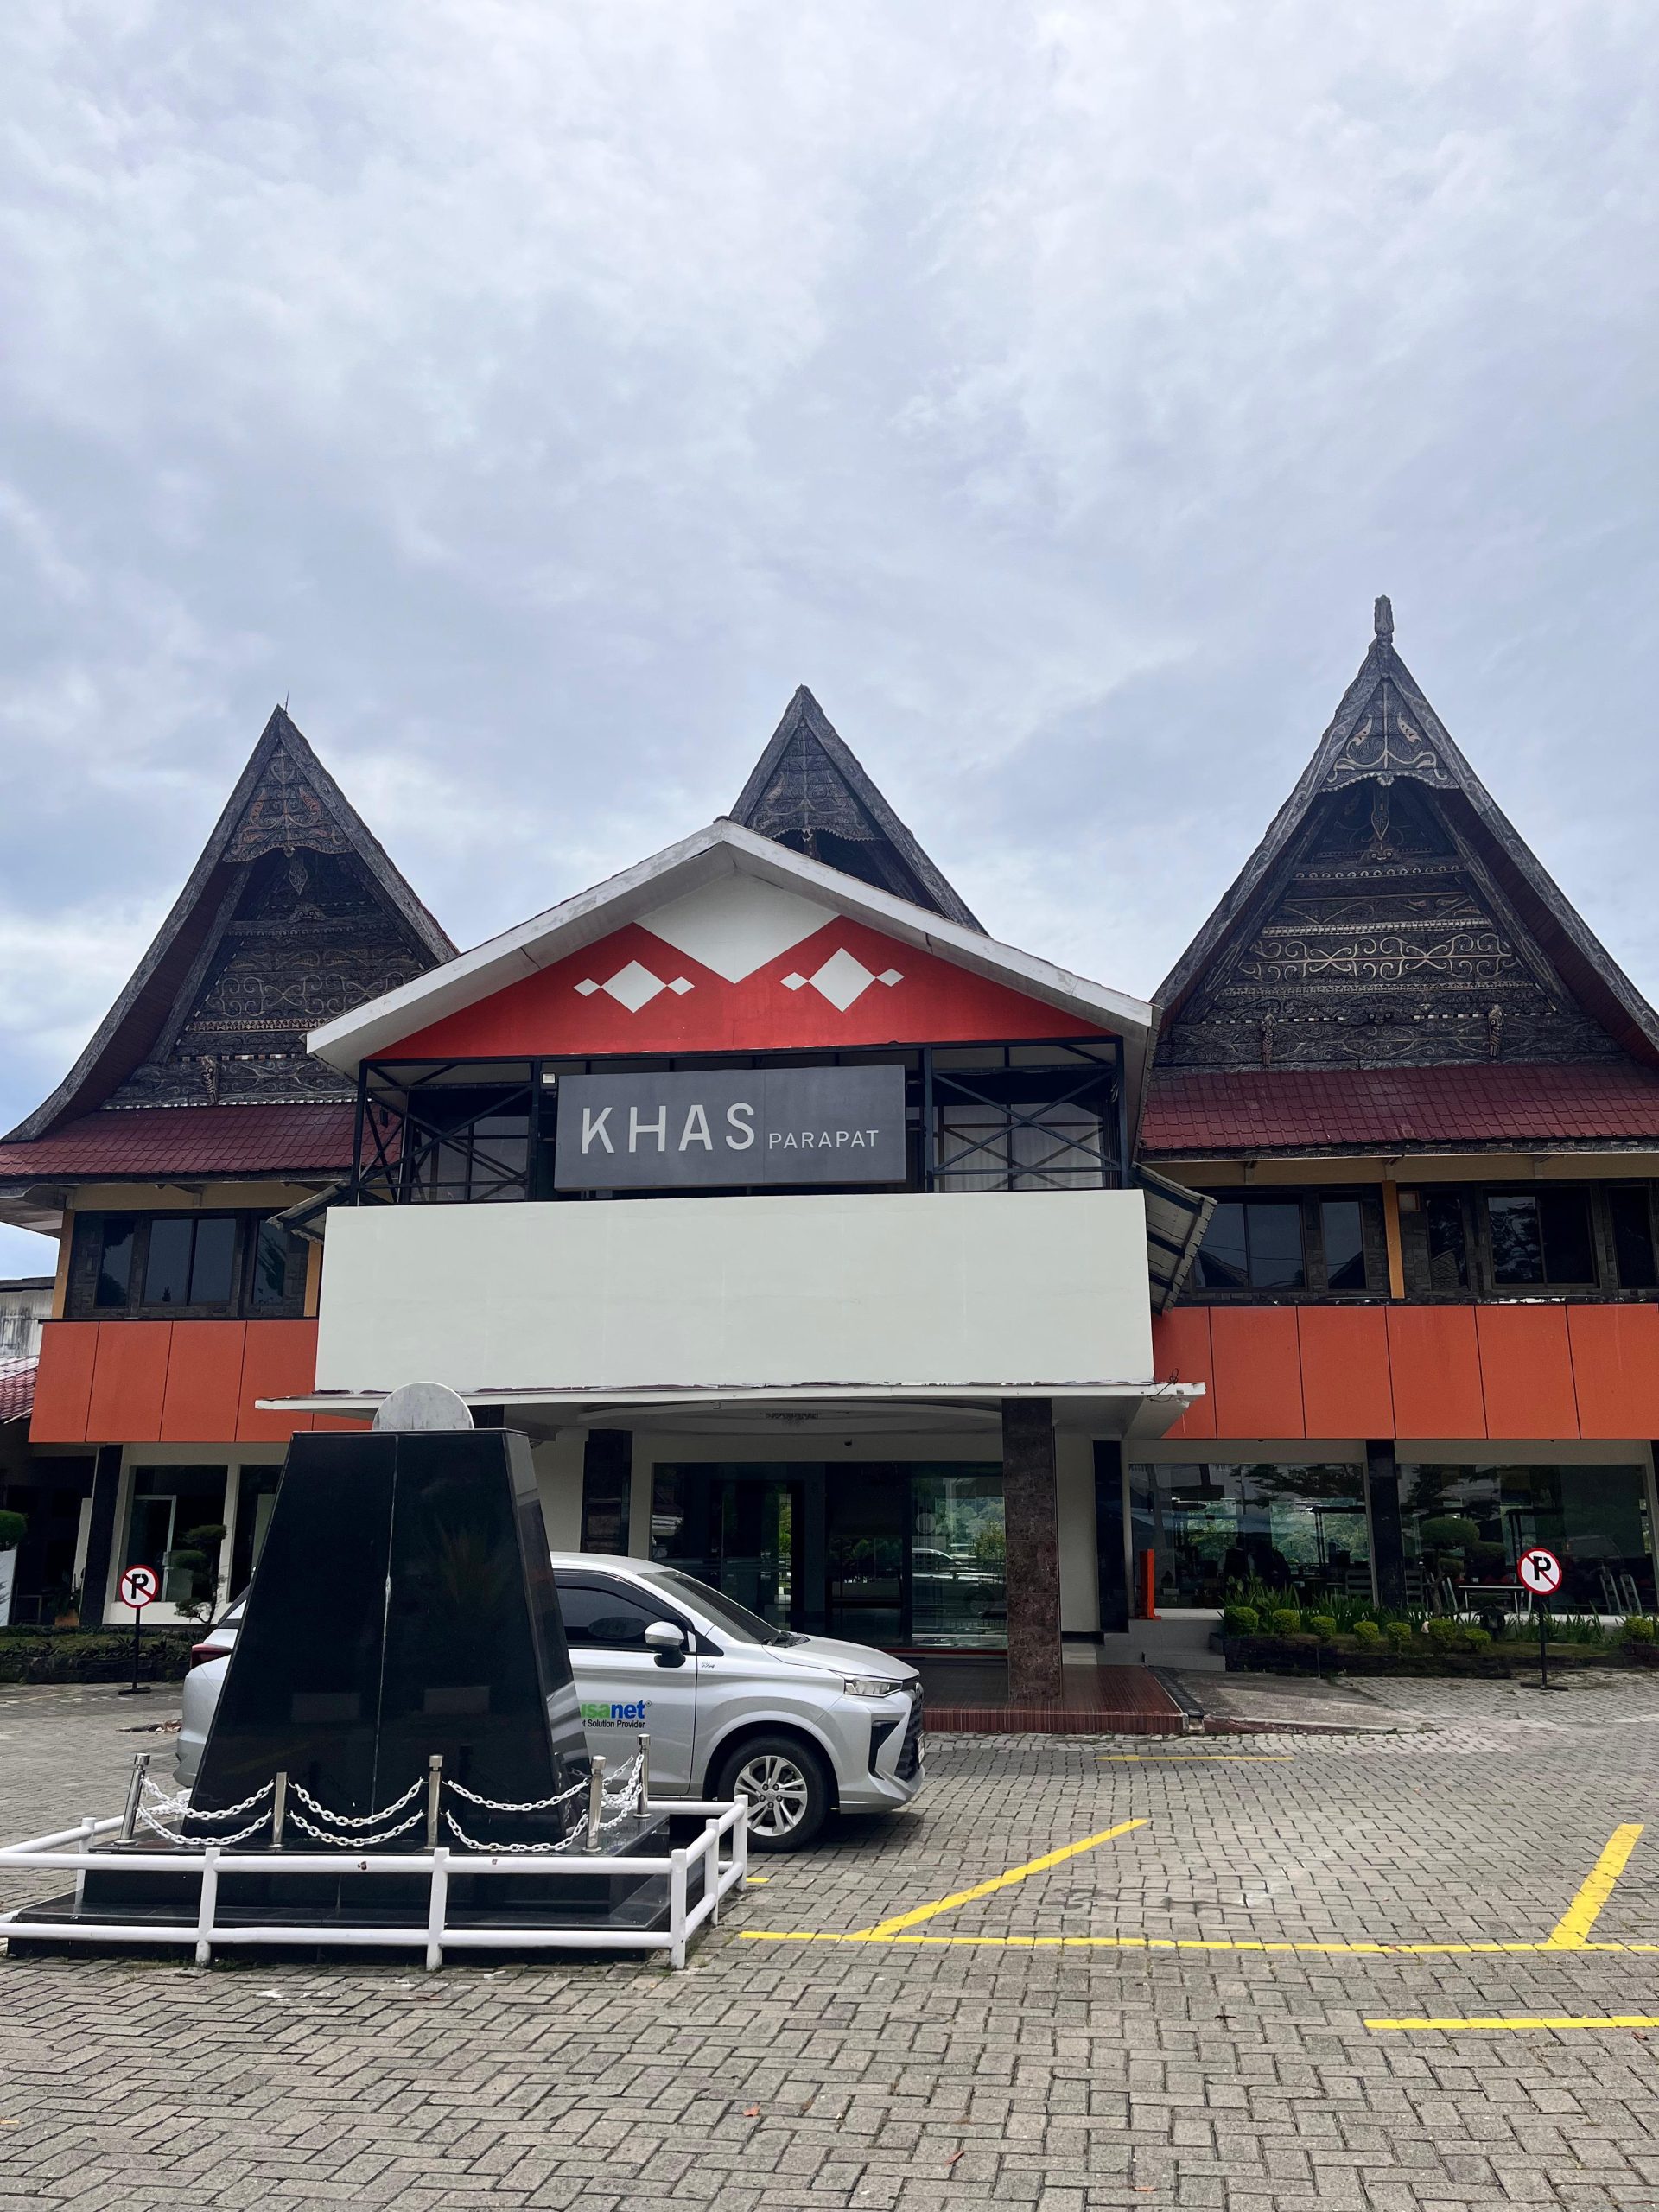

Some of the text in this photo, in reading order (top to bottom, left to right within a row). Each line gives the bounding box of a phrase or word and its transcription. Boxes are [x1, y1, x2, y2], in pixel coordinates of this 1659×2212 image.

[581, 1102, 880, 1154] KHAS PARAPAT
[1533, 1555, 1552, 1581] P
[130, 1573, 149, 1599] P
[588, 1719, 615, 1728] Solution
[616, 1719, 646, 1729] Provider
